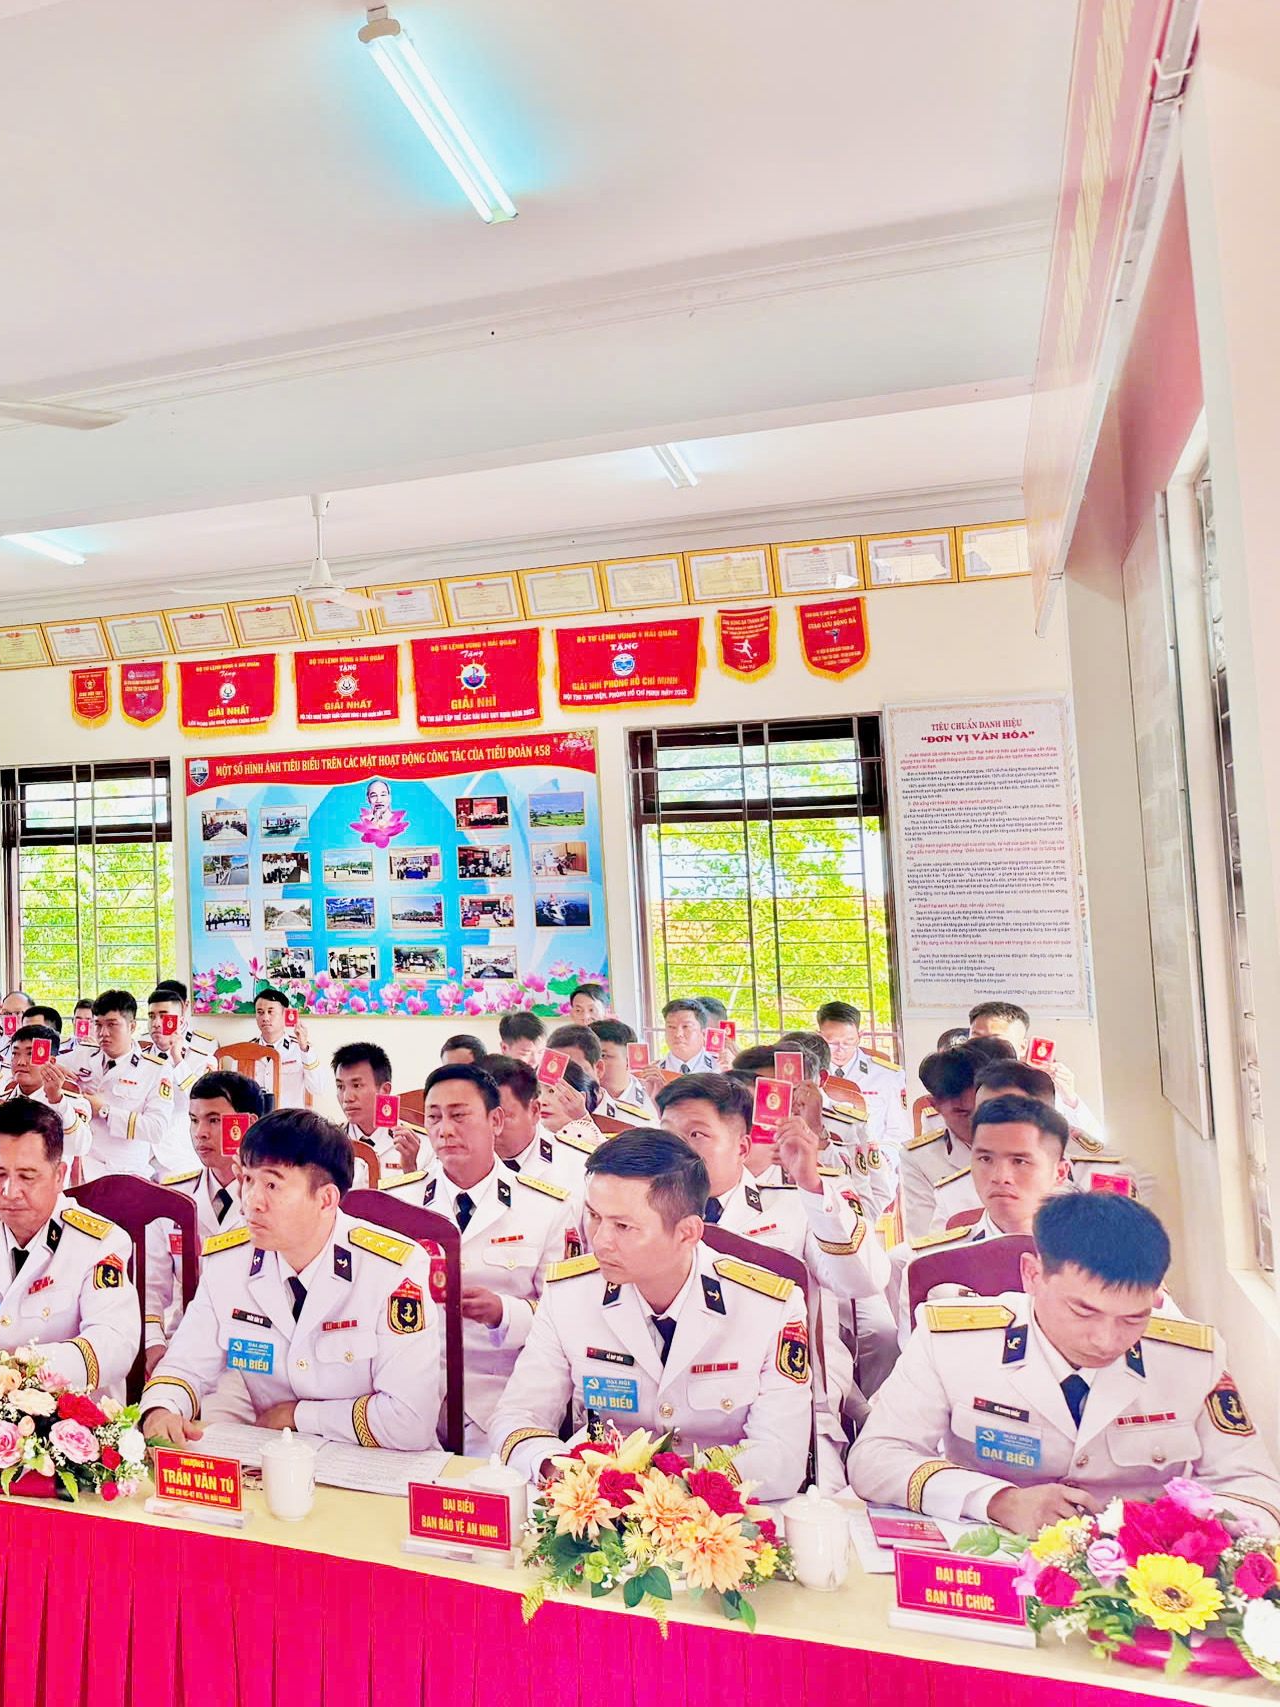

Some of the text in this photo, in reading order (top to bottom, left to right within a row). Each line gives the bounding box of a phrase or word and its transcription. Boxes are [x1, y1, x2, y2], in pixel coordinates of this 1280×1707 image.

[460, 650, 484, 658] Tặng
[609, 642, 639, 652] TẶNG
[339, 663, 357, 672] TẶNG
[630, 674, 640, 686] HỒ
[642, 675, 656, 685] CHÍ
[657, 675, 678, 685] MINH
[208, 703, 250, 717] GIẢI NHẤT
[324, 698, 372, 710] GIẢI NHẤT
[451, 695, 474, 710] GIẢI
[931, 717, 1023, 732] TIÊU CHUẨN DANH HIỆU
[956, 733, 969, 743] VỊ
[972, 730, 999, 741] VĂN
[215, 743, 551, 778] MỘT SỐ HÌNH ẢNH TIÊU BIỂU TRÊN CÁC MẶT HOẠT ĐỘNG CÔNG TÁC CỦA TIỂU ĐOÀN 458
[233, 1356, 269, 1371] ĐẠI BIỂU
[589, 1394, 633, 1409] ĐẠI BIỂU
[180, 1457, 214, 1470] THƯỢNG TÁ
[982, 1446, 1035, 1467] ĐẠI BIỂU
[162, 1467, 234, 1493] TRẦN VĂN TÚ
[442, 1496, 475, 1514] ĐẠI BIỂU
[421, 1514, 498, 1539] BAN BẢO VỆ AN NINH
[935, 1565, 981, 1587] ĐẠI BIỂU
[925, 1587, 995, 1612] BAN TỔ CHỨC
